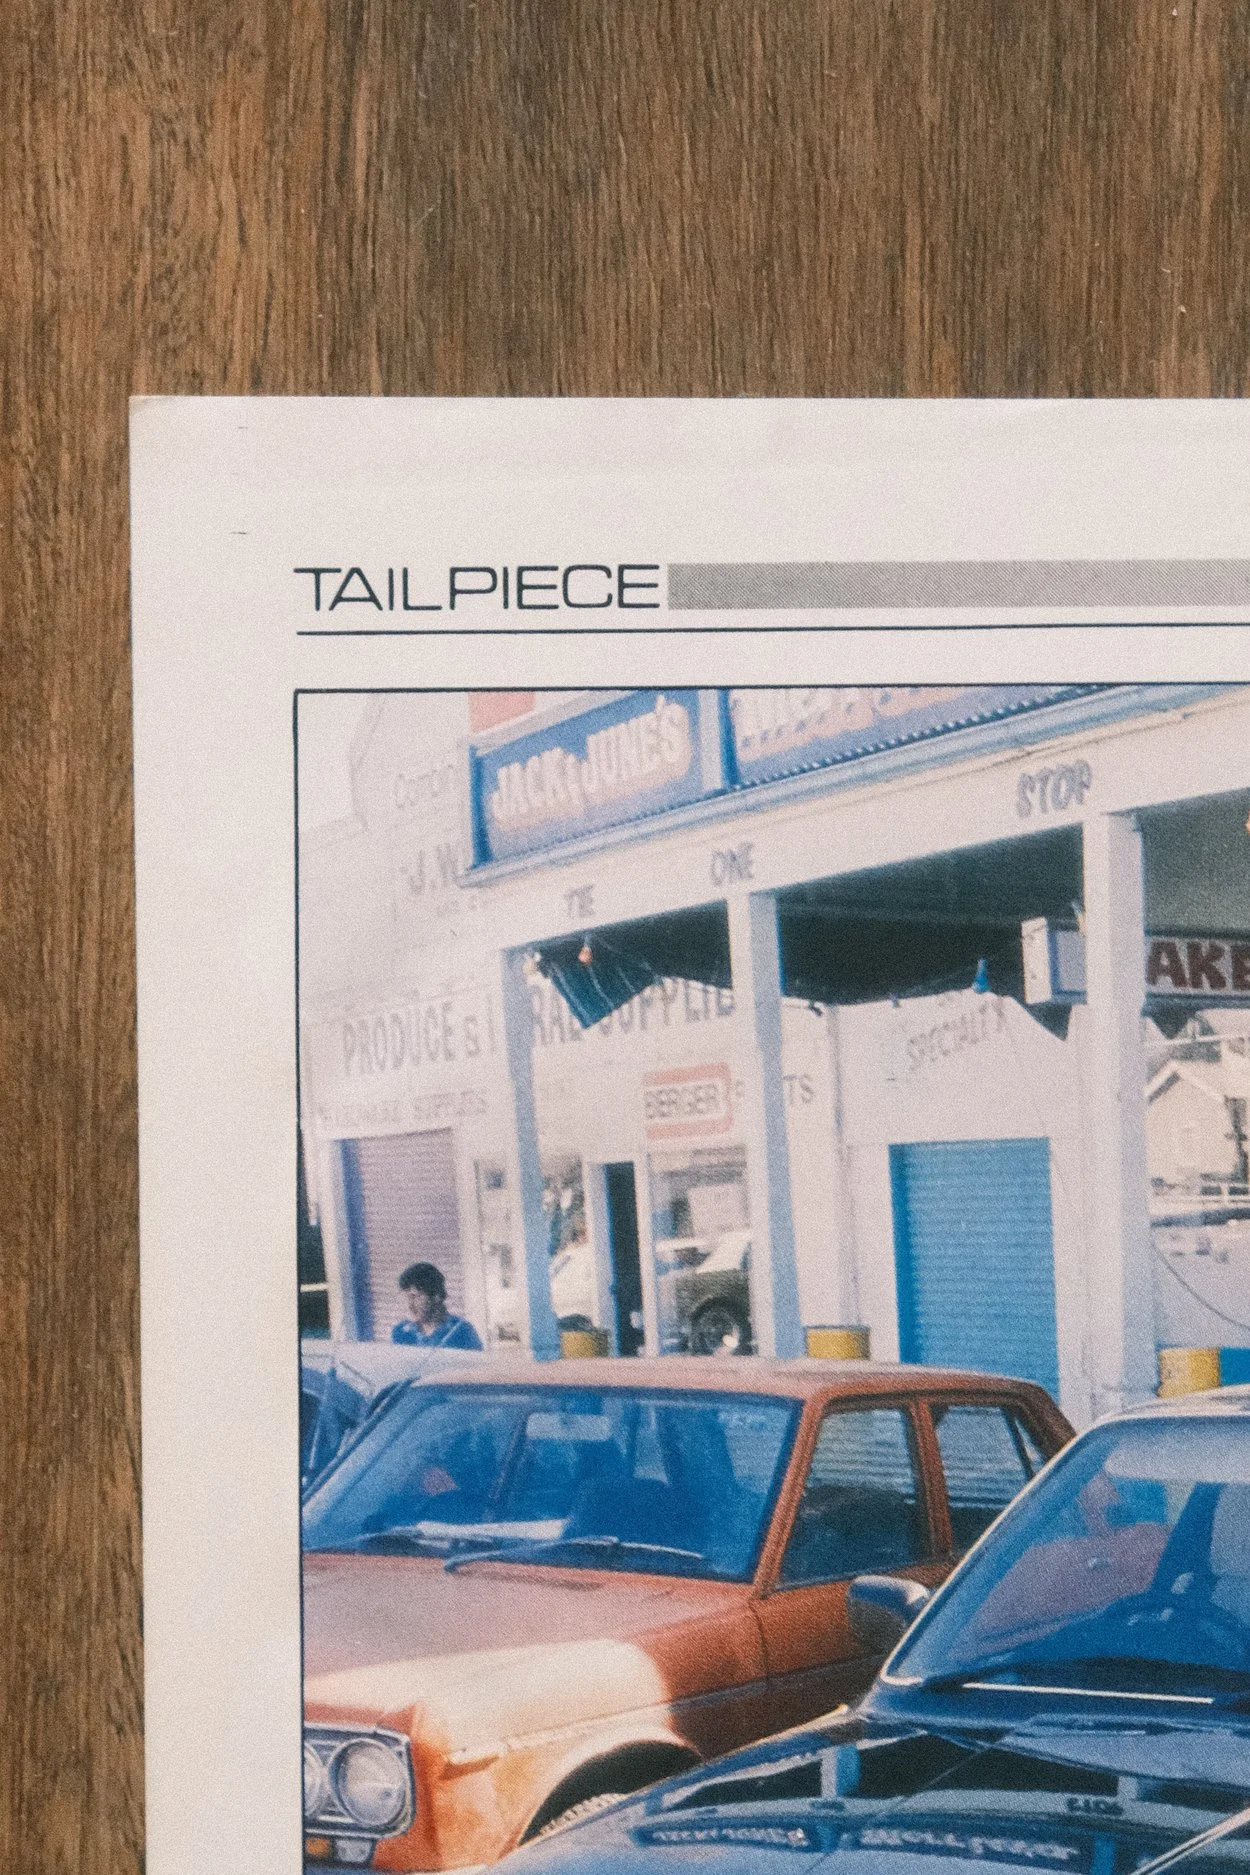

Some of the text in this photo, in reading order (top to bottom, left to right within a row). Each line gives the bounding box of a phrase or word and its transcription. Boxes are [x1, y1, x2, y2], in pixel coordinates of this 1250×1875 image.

[293, 564, 659, 611] TAILPIECE
[1016, 759, 1093, 819] STOP
[710, 842, 755, 887] ONE
[342, 1000, 456, 1077] PRODUCE
[645, 1083, 719, 1120] BERGER
